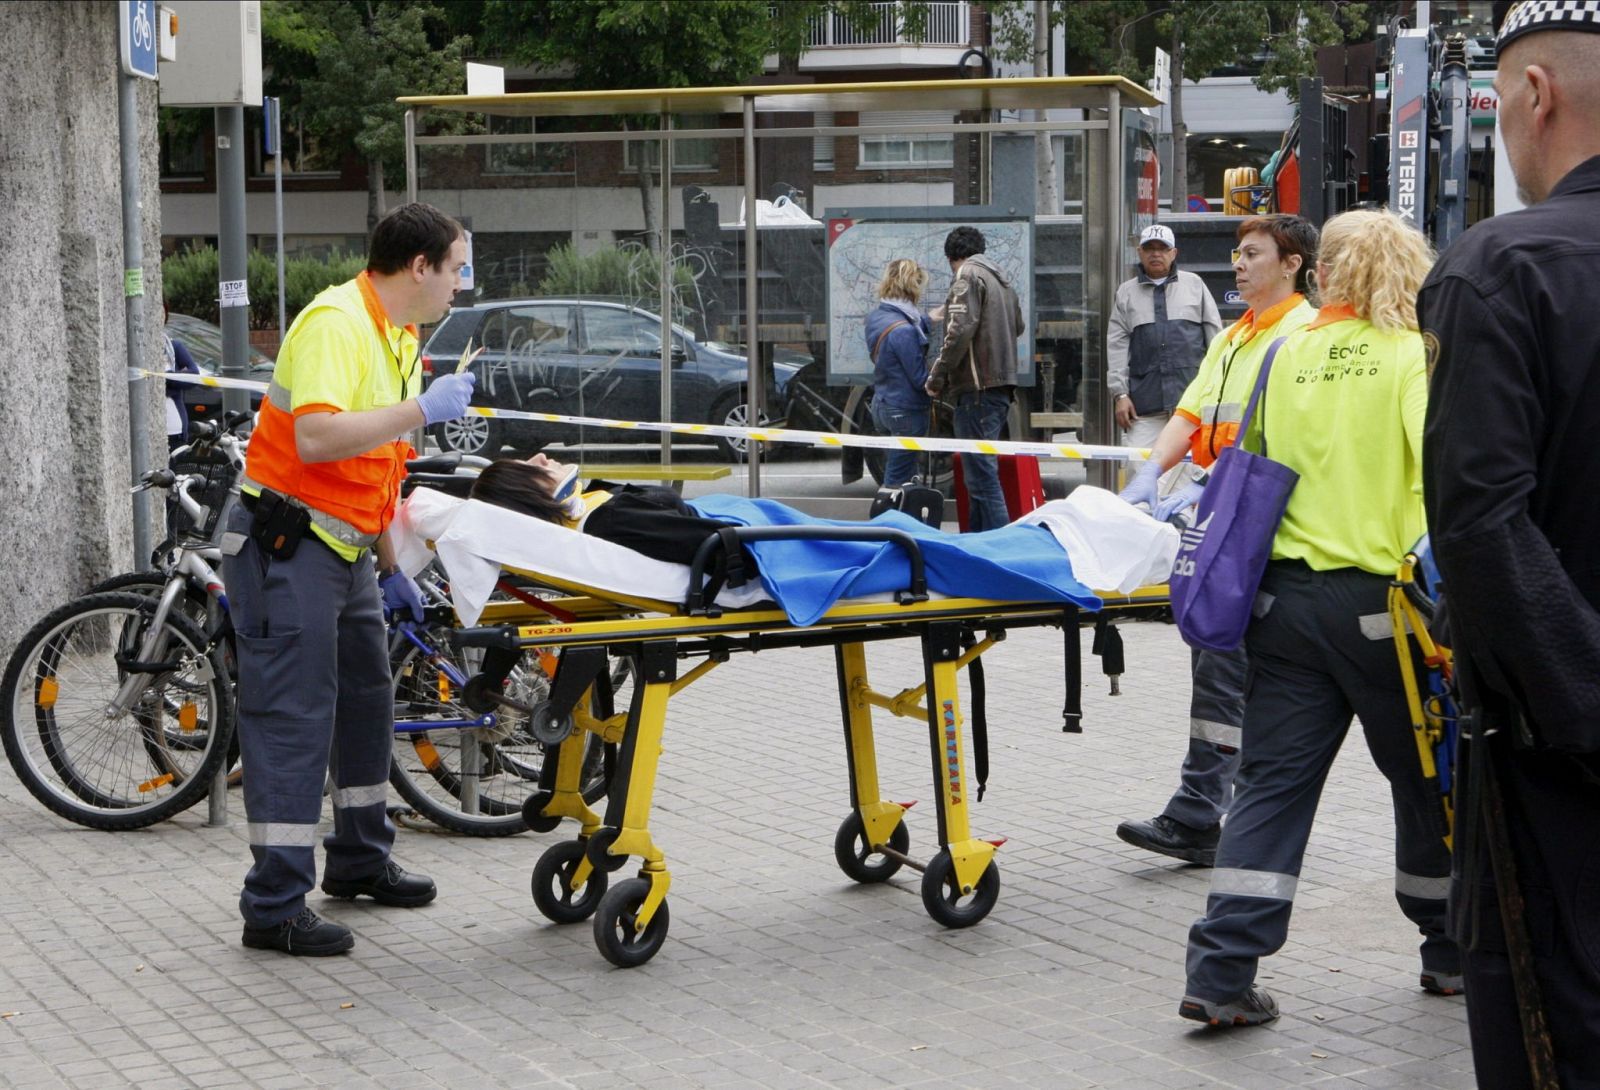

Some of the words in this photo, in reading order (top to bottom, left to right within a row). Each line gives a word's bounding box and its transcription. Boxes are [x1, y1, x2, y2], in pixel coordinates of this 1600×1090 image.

[1399, 152, 1416, 220] TEREX
[224, 281, 243, 291] STOP
[527, 627, 573, 636] TG-230
